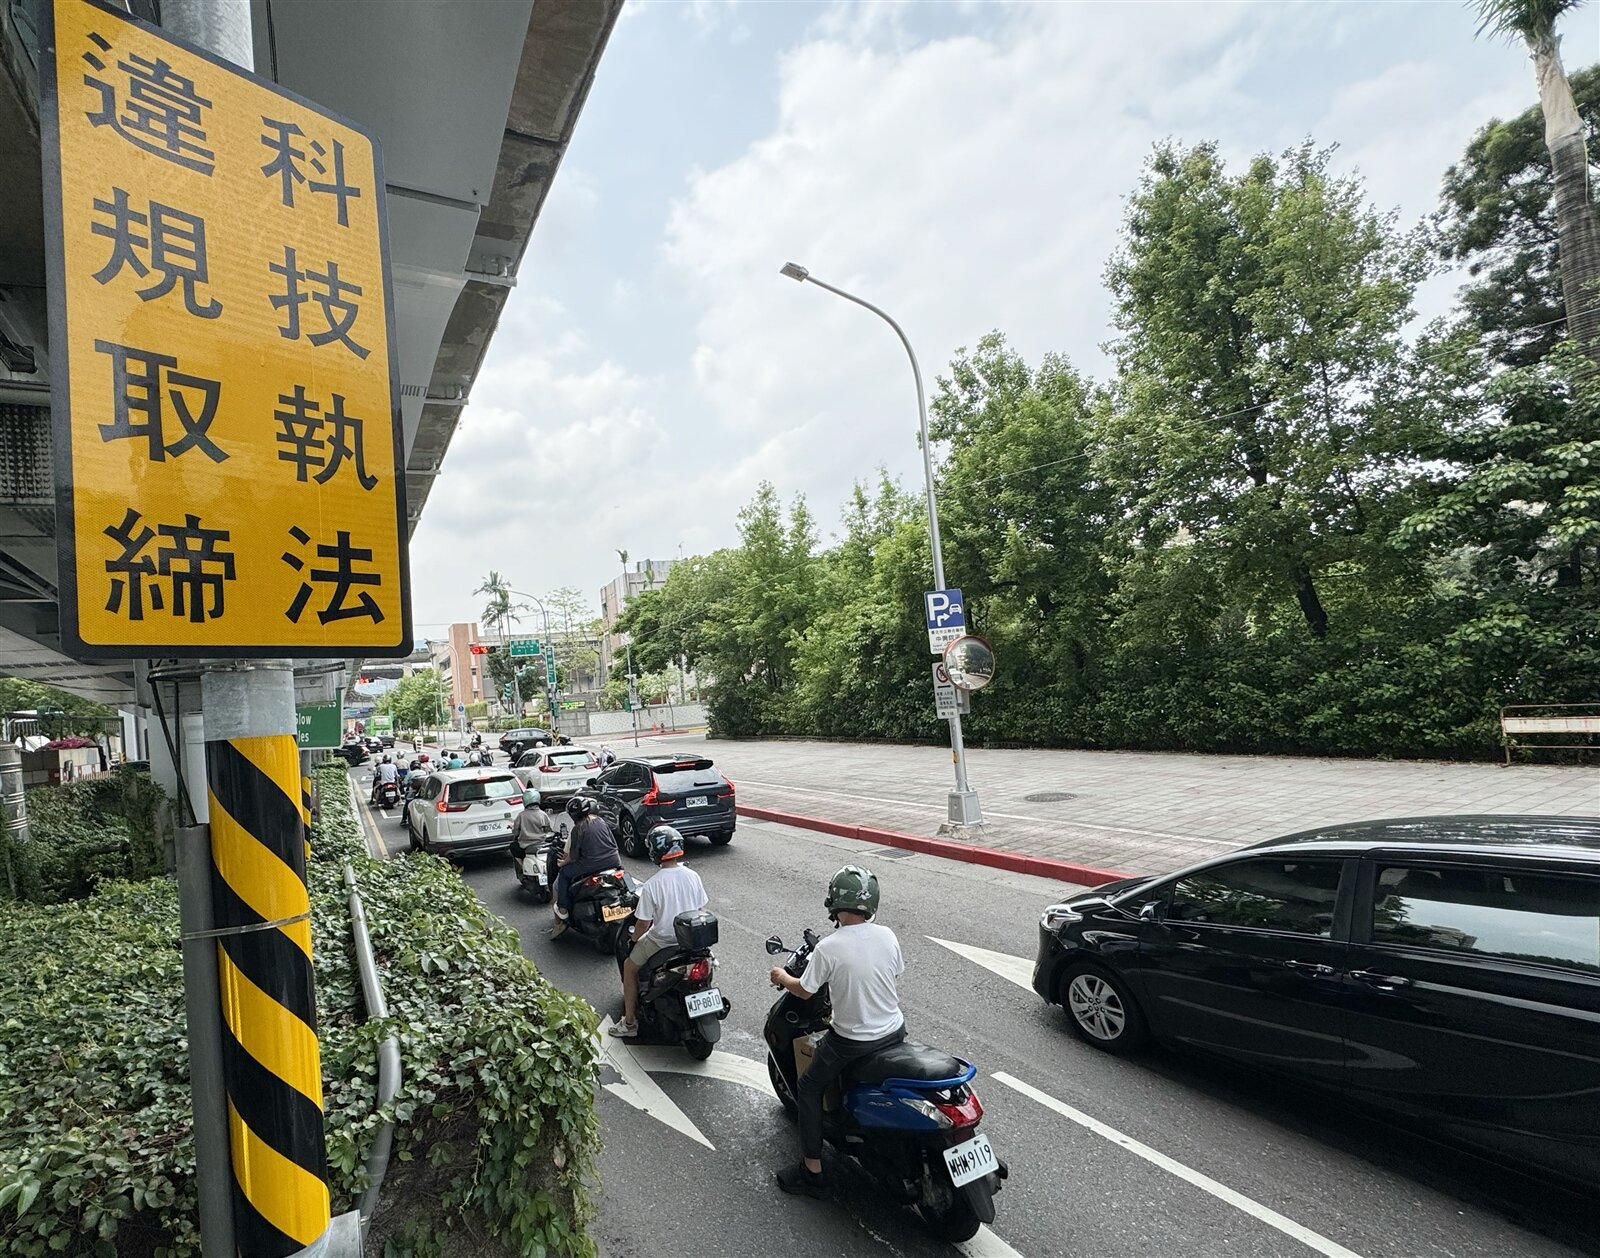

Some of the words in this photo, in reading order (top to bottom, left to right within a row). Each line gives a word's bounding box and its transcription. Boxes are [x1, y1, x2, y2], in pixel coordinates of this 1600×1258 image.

[82, 31, 237, 624] 違規取締
[259, 115, 386, 627] 科技執法
[927, 592, 950, 621] P
[298, 730, 310, 742] les
[687, 994, 721, 1013] MJP-8810
